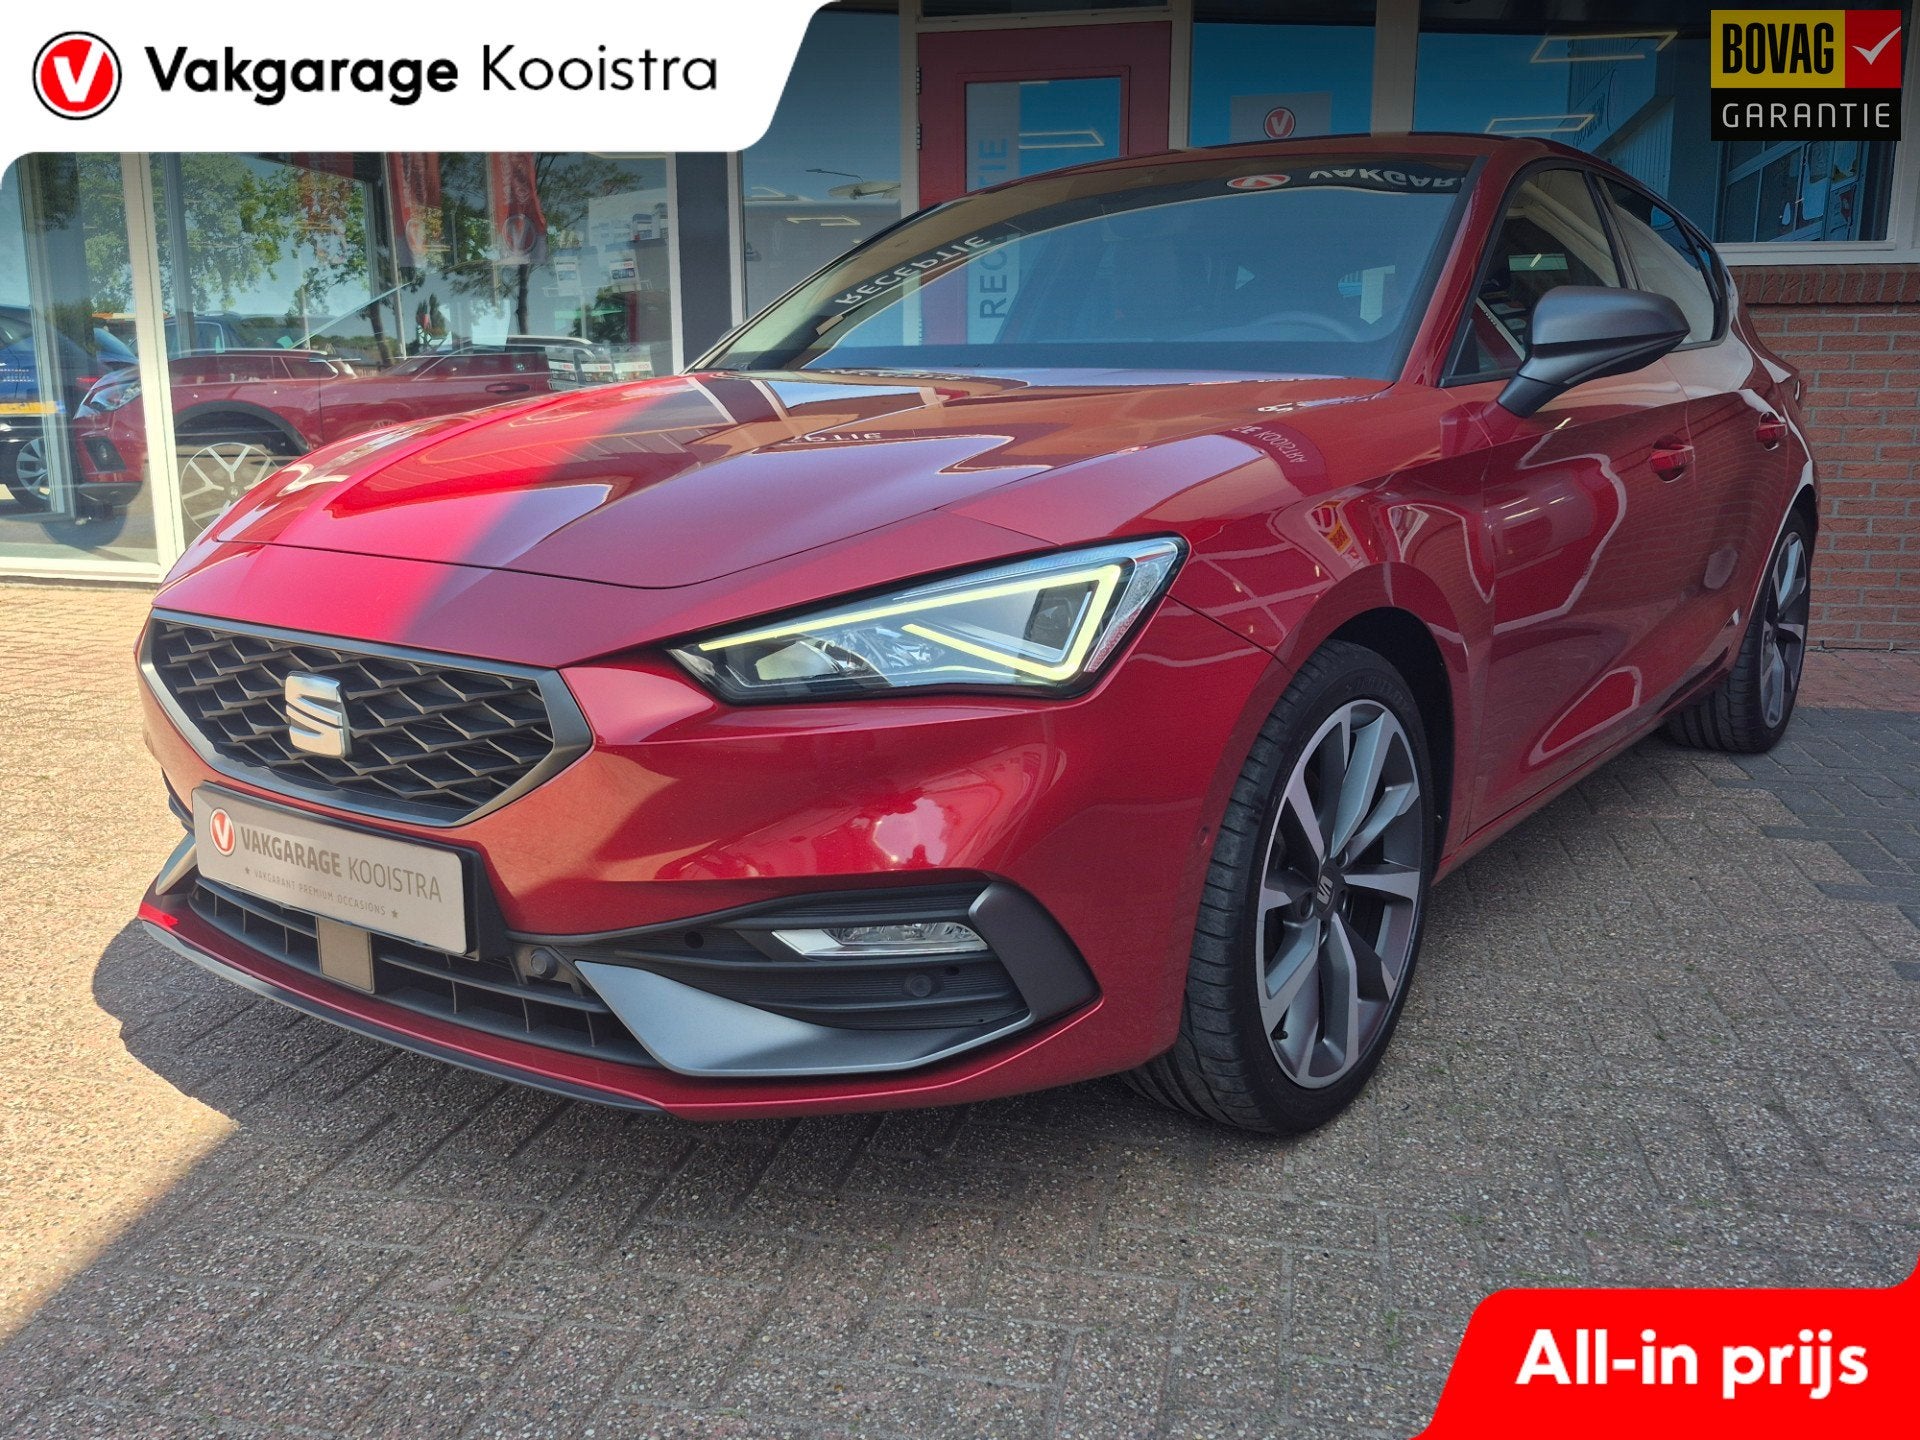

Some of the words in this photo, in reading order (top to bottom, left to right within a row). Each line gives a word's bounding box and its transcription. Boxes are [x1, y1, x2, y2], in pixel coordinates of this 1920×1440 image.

[240, 826, 342, 877] VAKGARAGE
[348, 857, 442, 903] KOOISTRA
[253, 870, 296, 891] VAKGARANT
[299, 882, 334, 902] PREMIUM
[337, 893, 387, 916] OCCASIONS
